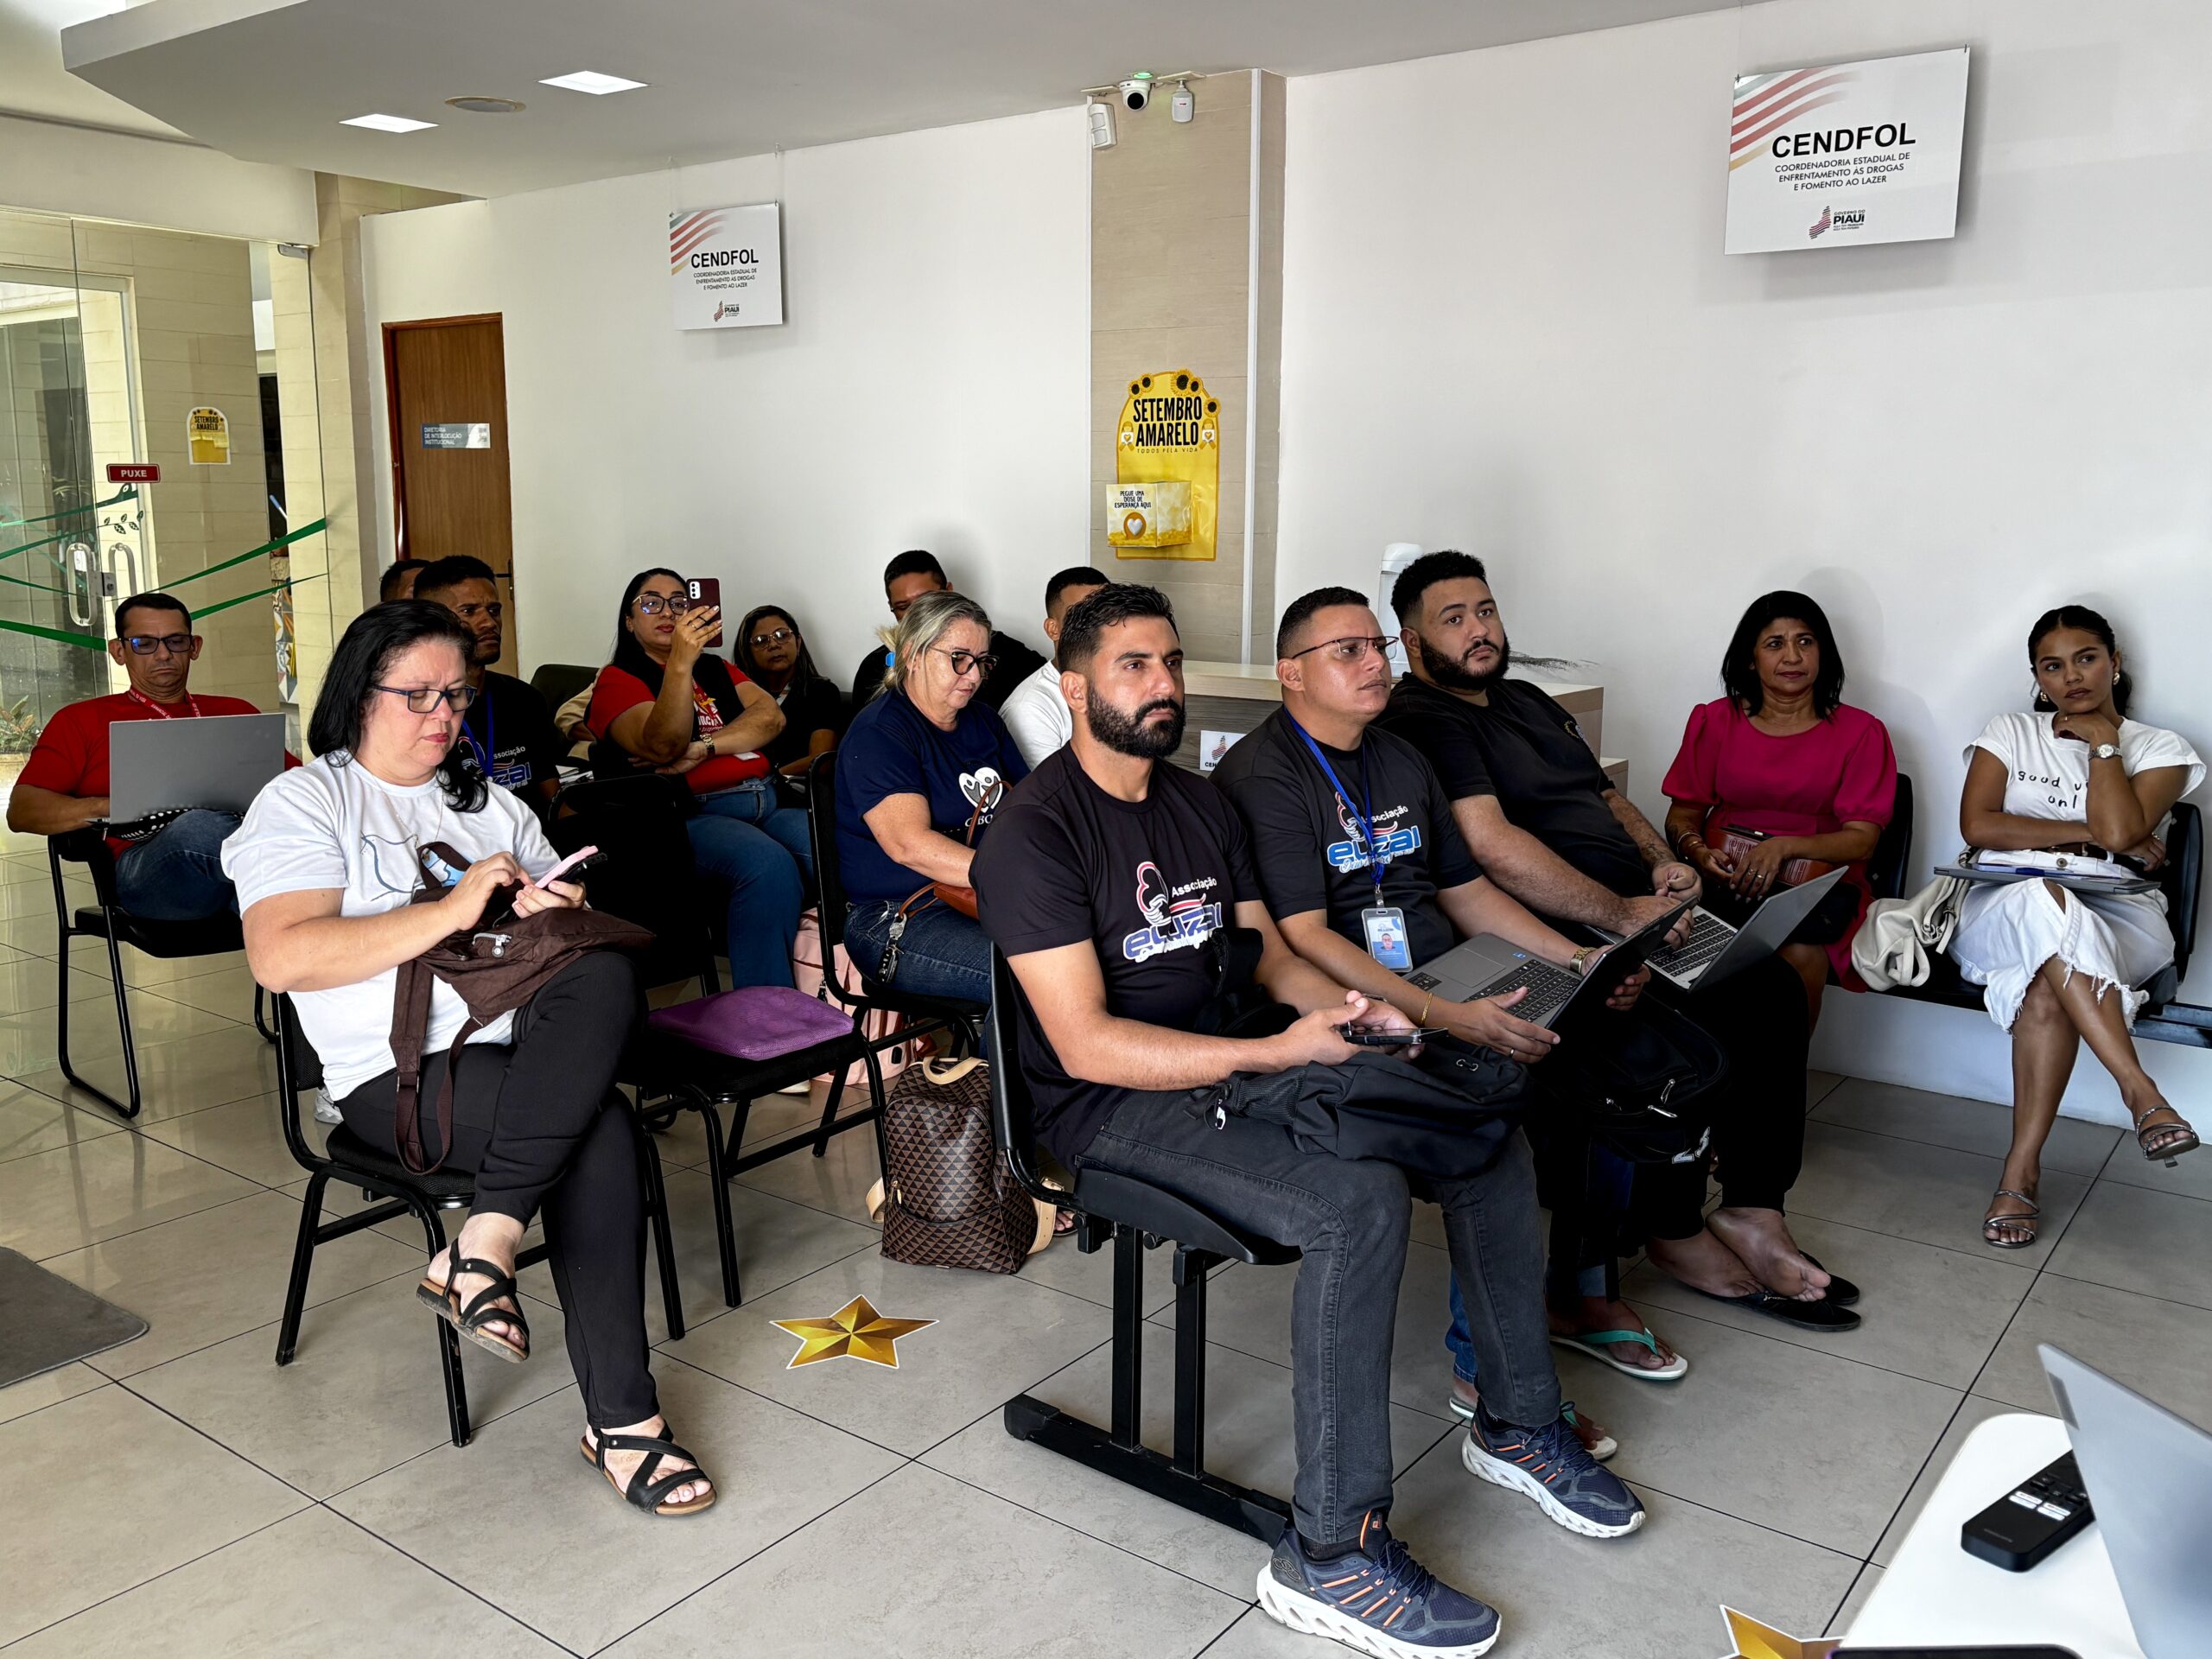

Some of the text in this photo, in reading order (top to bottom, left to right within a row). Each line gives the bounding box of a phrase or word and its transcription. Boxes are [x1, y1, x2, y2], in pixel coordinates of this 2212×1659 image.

[1772, 123, 1916, 158] CENDFOL
[1775, 152, 1910, 173] COORDENADORIA ESTADUAL DE
[1778, 168, 1851, 182] ENFRENTAMENTO
[1866, 163, 1904, 174] DROGAS
[1801, 179, 1843, 190] FOMENTO
[1846, 178, 1859, 187] AO
[1861, 175, 1887, 185] LAZER
[691, 249, 759, 268] CENDFOL
[1133, 396, 1202, 422] SETEMBRO
[1135, 422, 1199, 447] AMARELO
[493, 746, 526, 760] ssociação
[2018, 771, 2060, 788] good
[2048, 795, 2077, 809] onl
